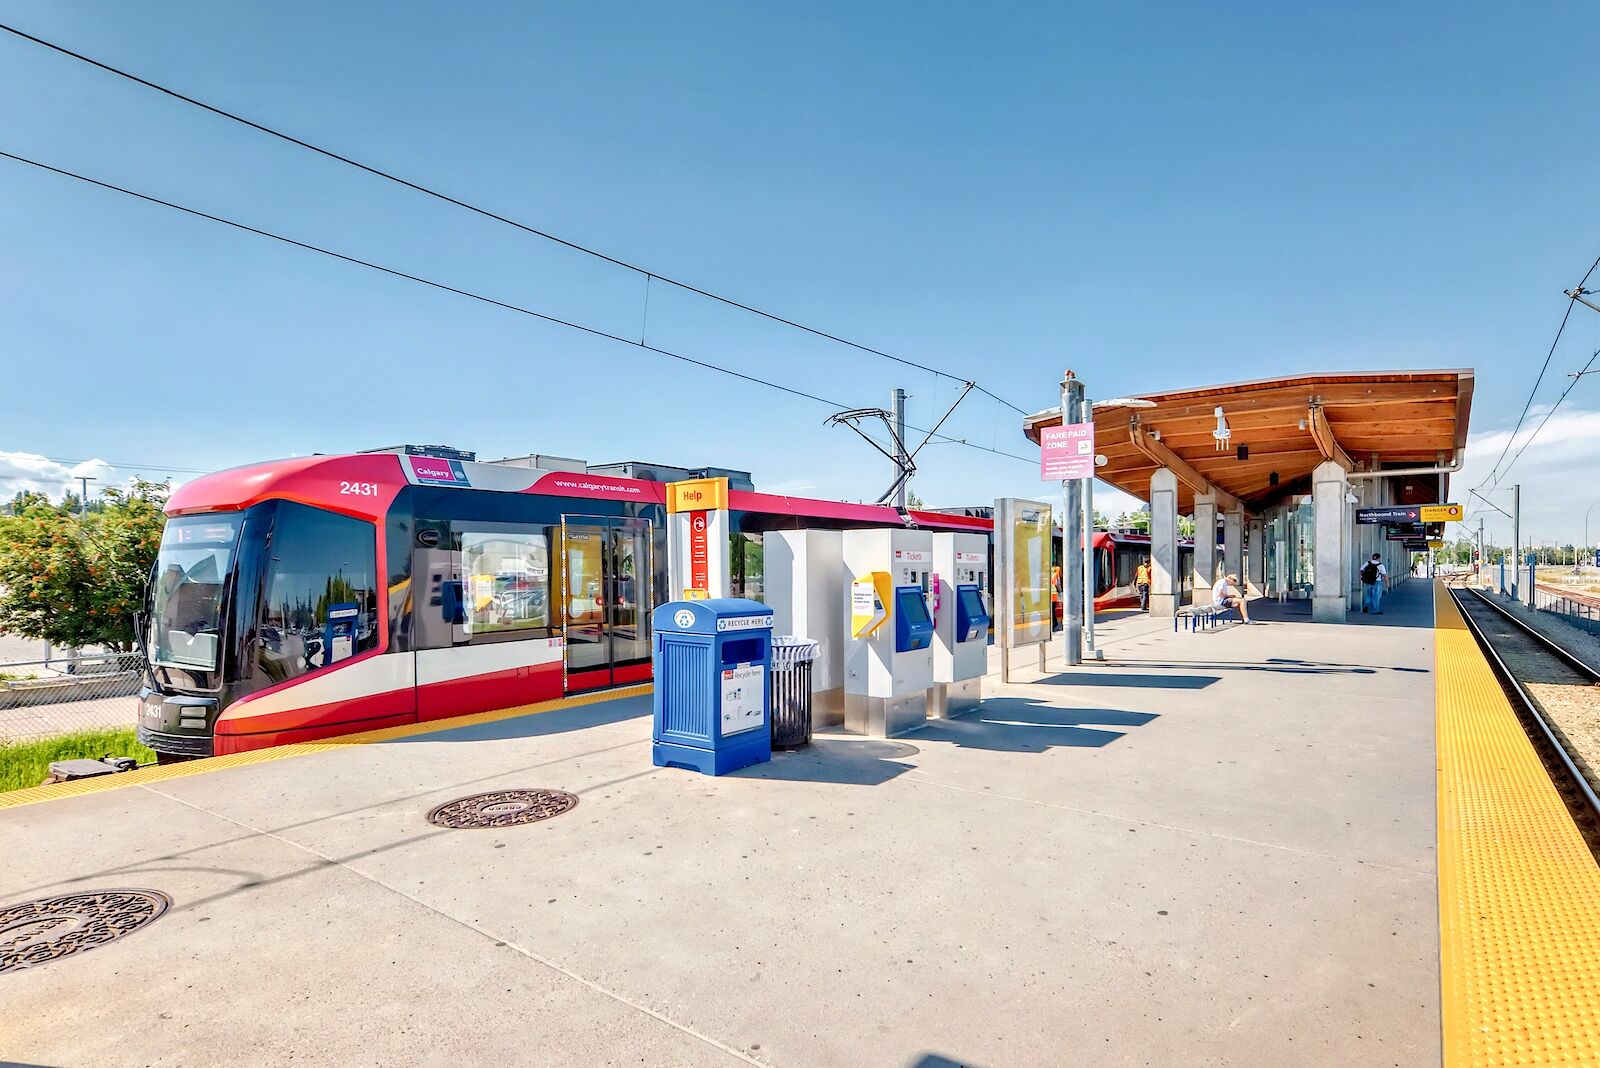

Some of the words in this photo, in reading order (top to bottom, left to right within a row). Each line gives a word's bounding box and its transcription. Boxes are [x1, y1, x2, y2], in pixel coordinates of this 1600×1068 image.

[1046, 432, 1068, 440] FARE
[1068, 430, 1087, 438] PAID
[1046, 441, 1068, 449] ZONE
[416, 467, 449, 478] Calgary
[339, 481, 379, 497] 2431
[554, 479, 642, 494] www.calgarytransit.com
[683, 490, 703, 502] Help
[906, 551, 922, 560] Tickets
[727, 619, 750, 627] RECYCLE
[734, 671, 751, 680] Recycle
[751, 669, 761, 677] here
[146, 703, 162, 719] 2431
